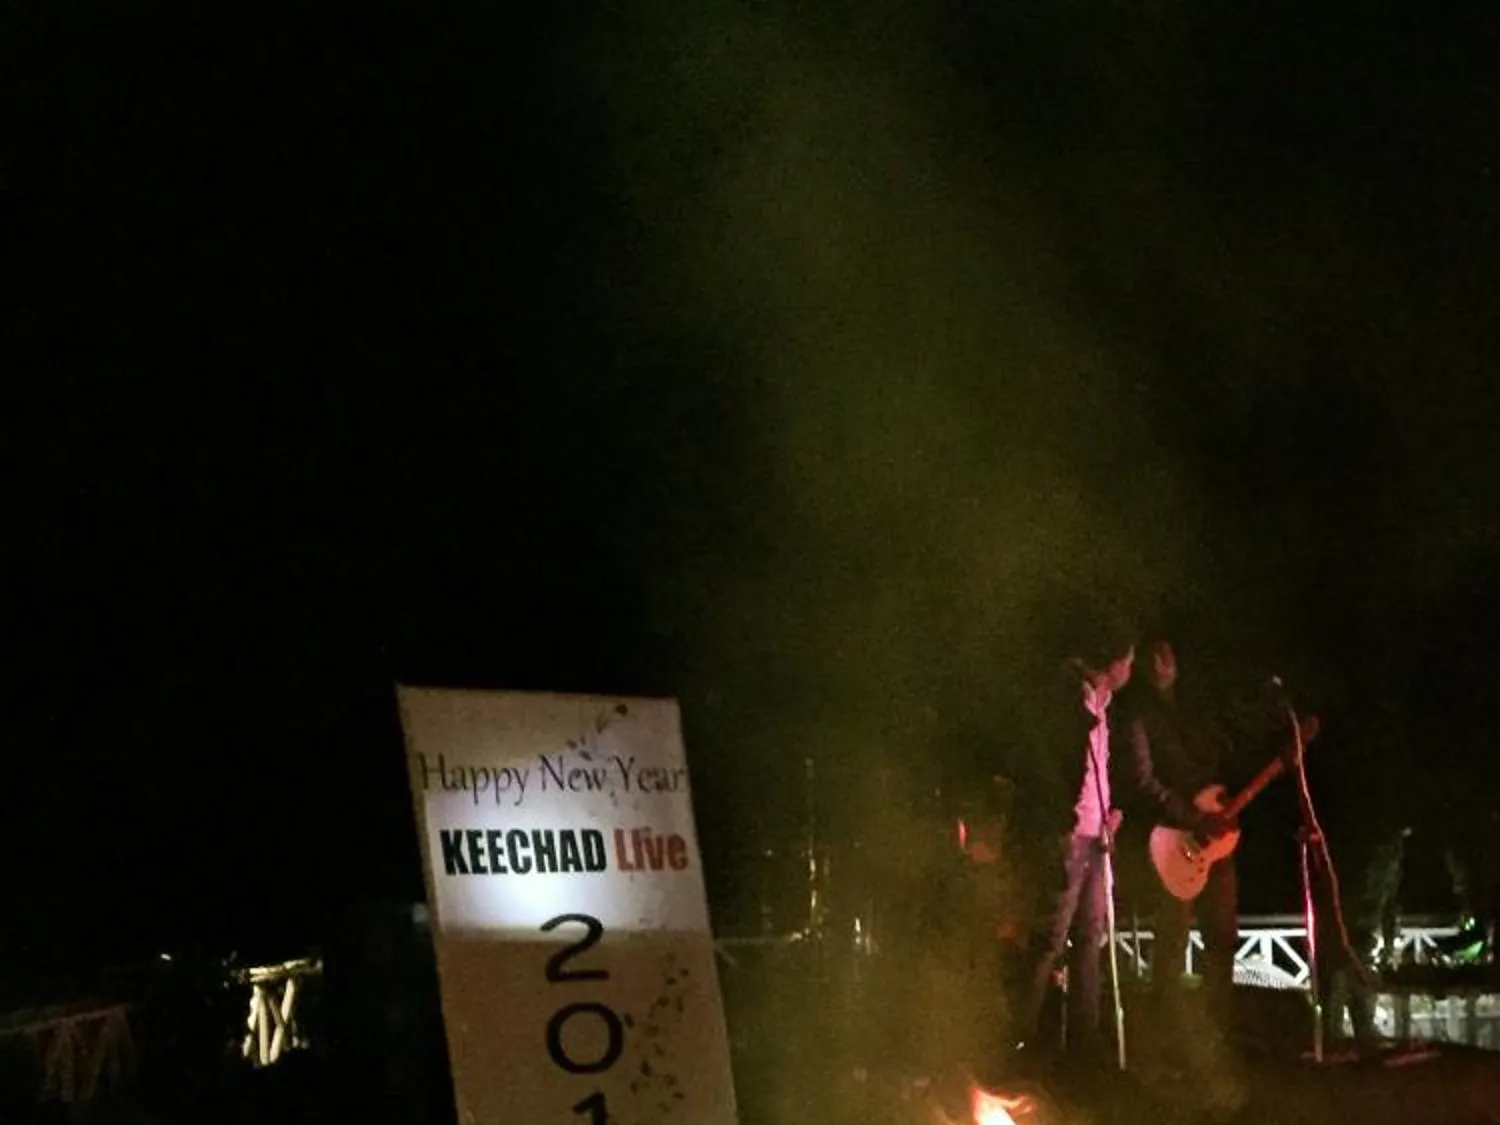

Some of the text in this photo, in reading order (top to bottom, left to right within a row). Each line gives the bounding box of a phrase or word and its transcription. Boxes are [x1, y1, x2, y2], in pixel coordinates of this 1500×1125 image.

[417, 753, 689, 805] Happy New Year
[440, 828, 607, 876] KEECHAD
